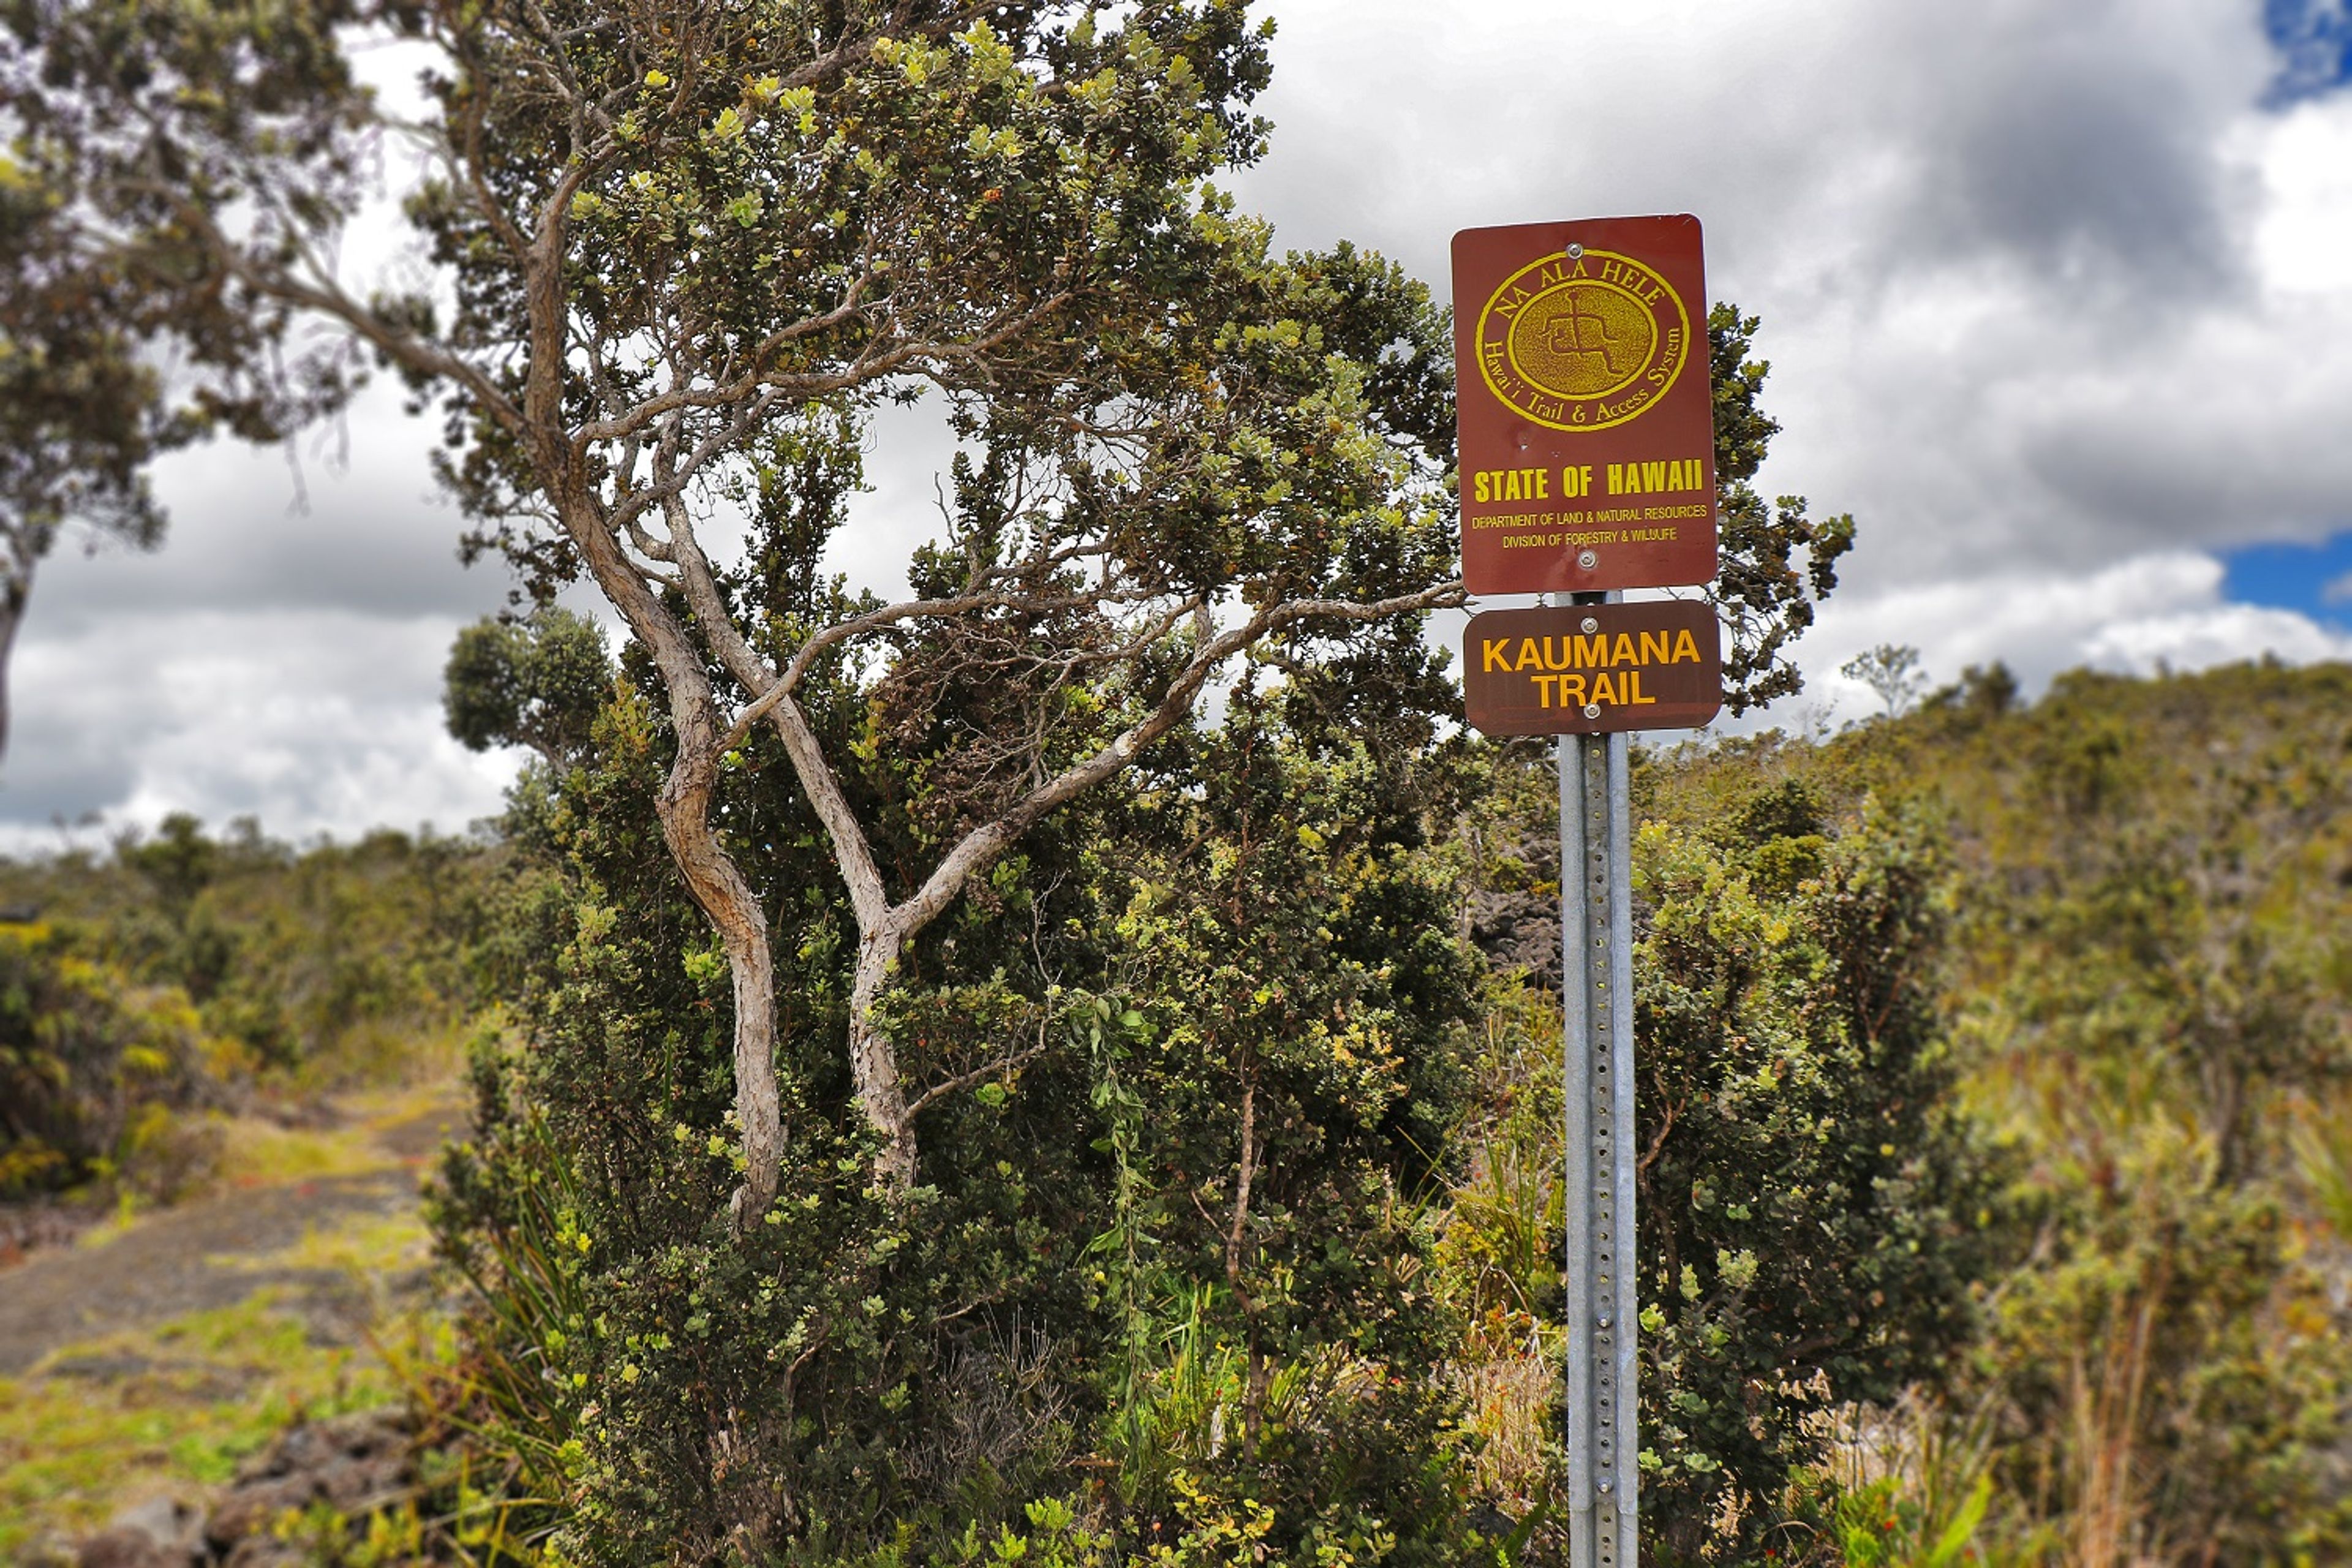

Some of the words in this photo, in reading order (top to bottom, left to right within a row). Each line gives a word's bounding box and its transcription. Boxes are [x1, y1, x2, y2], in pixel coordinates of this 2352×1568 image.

[1494, 287, 1531, 319] NA
[1540, 260, 1588, 287] ALA
[1600, 260, 1666, 307] HELE
[1527, 393, 1564, 421] Trail
[1572, 405, 1586, 422] &
[1596, 388, 1650, 421] Access
[1648, 327, 1679, 387] System
[1474, 469, 1549, 503] STATE
[1563, 466, 1593, 498] OF
[1607, 459, 1702, 495] HAWAII
[1472, 514, 1538, 529] DEPARTMENT
[1540, 512, 1554, 526] OF
[1556, 511, 1583, 524] LAND
[1586, 510, 1594, 523] &
[1597, 508, 1642, 522] NATURAL
[1645, 505, 1707, 520] RESOURCES
[1503, 534, 1545, 548] DIVISION
[1549, 533, 1562, 546] OF
[1566, 530, 1618, 545] FORESTRY
[1621, 529, 1629, 543] &
[1630, 527, 1677, 542] WILDLIFE
[1483, 628, 1702, 673] KAUMANA
[1531, 671, 1656, 708] TRAIL
